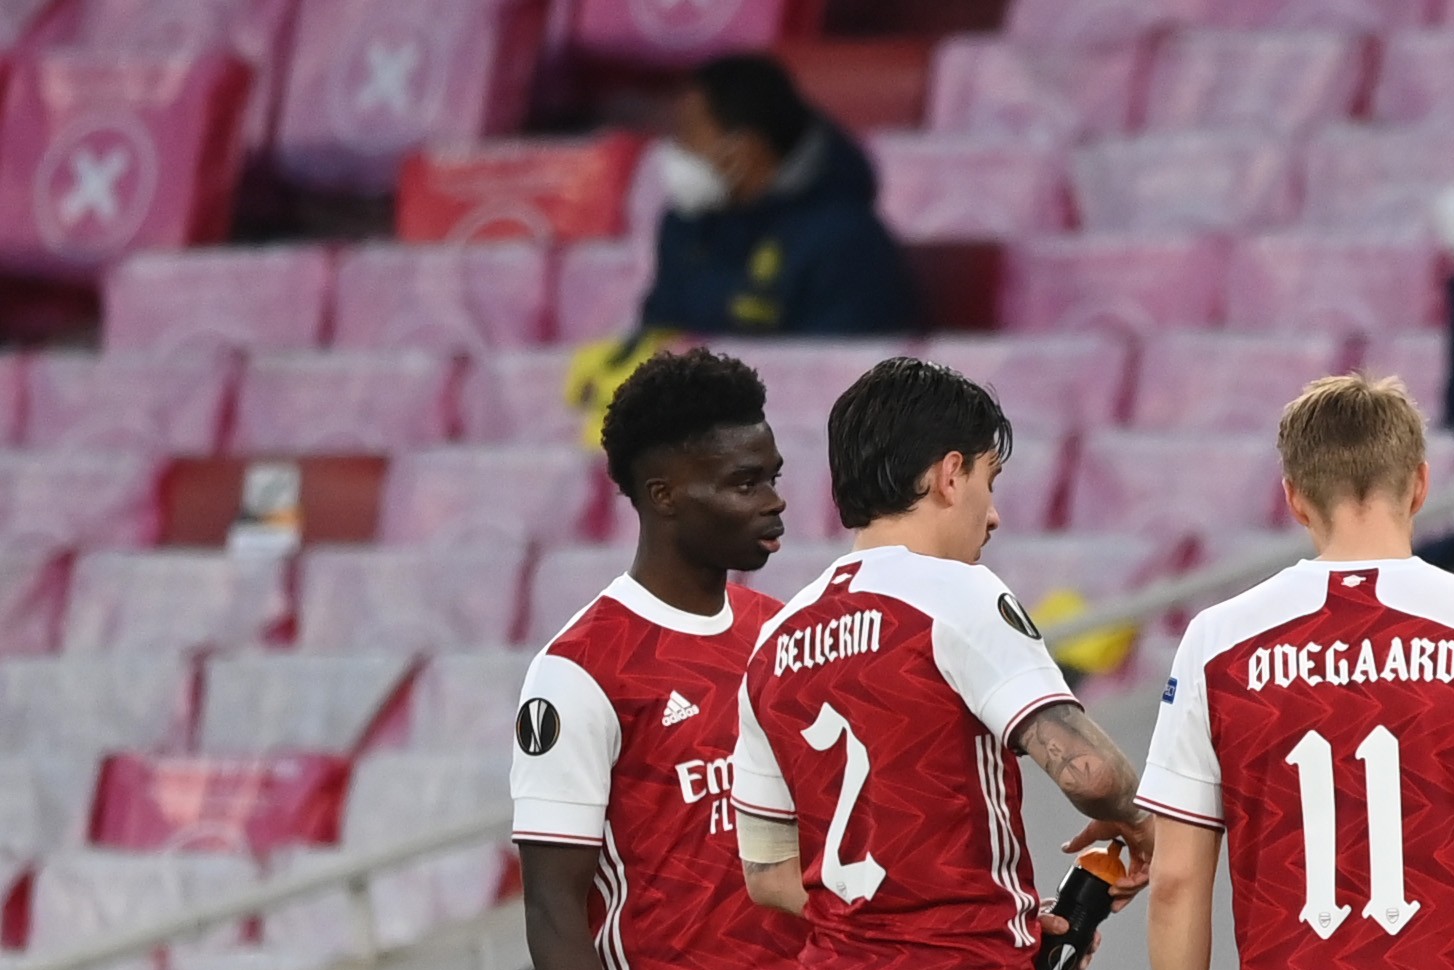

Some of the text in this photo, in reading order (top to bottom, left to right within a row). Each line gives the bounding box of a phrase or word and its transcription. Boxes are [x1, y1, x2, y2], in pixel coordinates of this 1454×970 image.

[774, 609, 882, 677] BELLERIN
[662, 704, 700, 727] adidas
[800, 702, 886, 905] 2
[1285, 725, 1420, 939] 11
